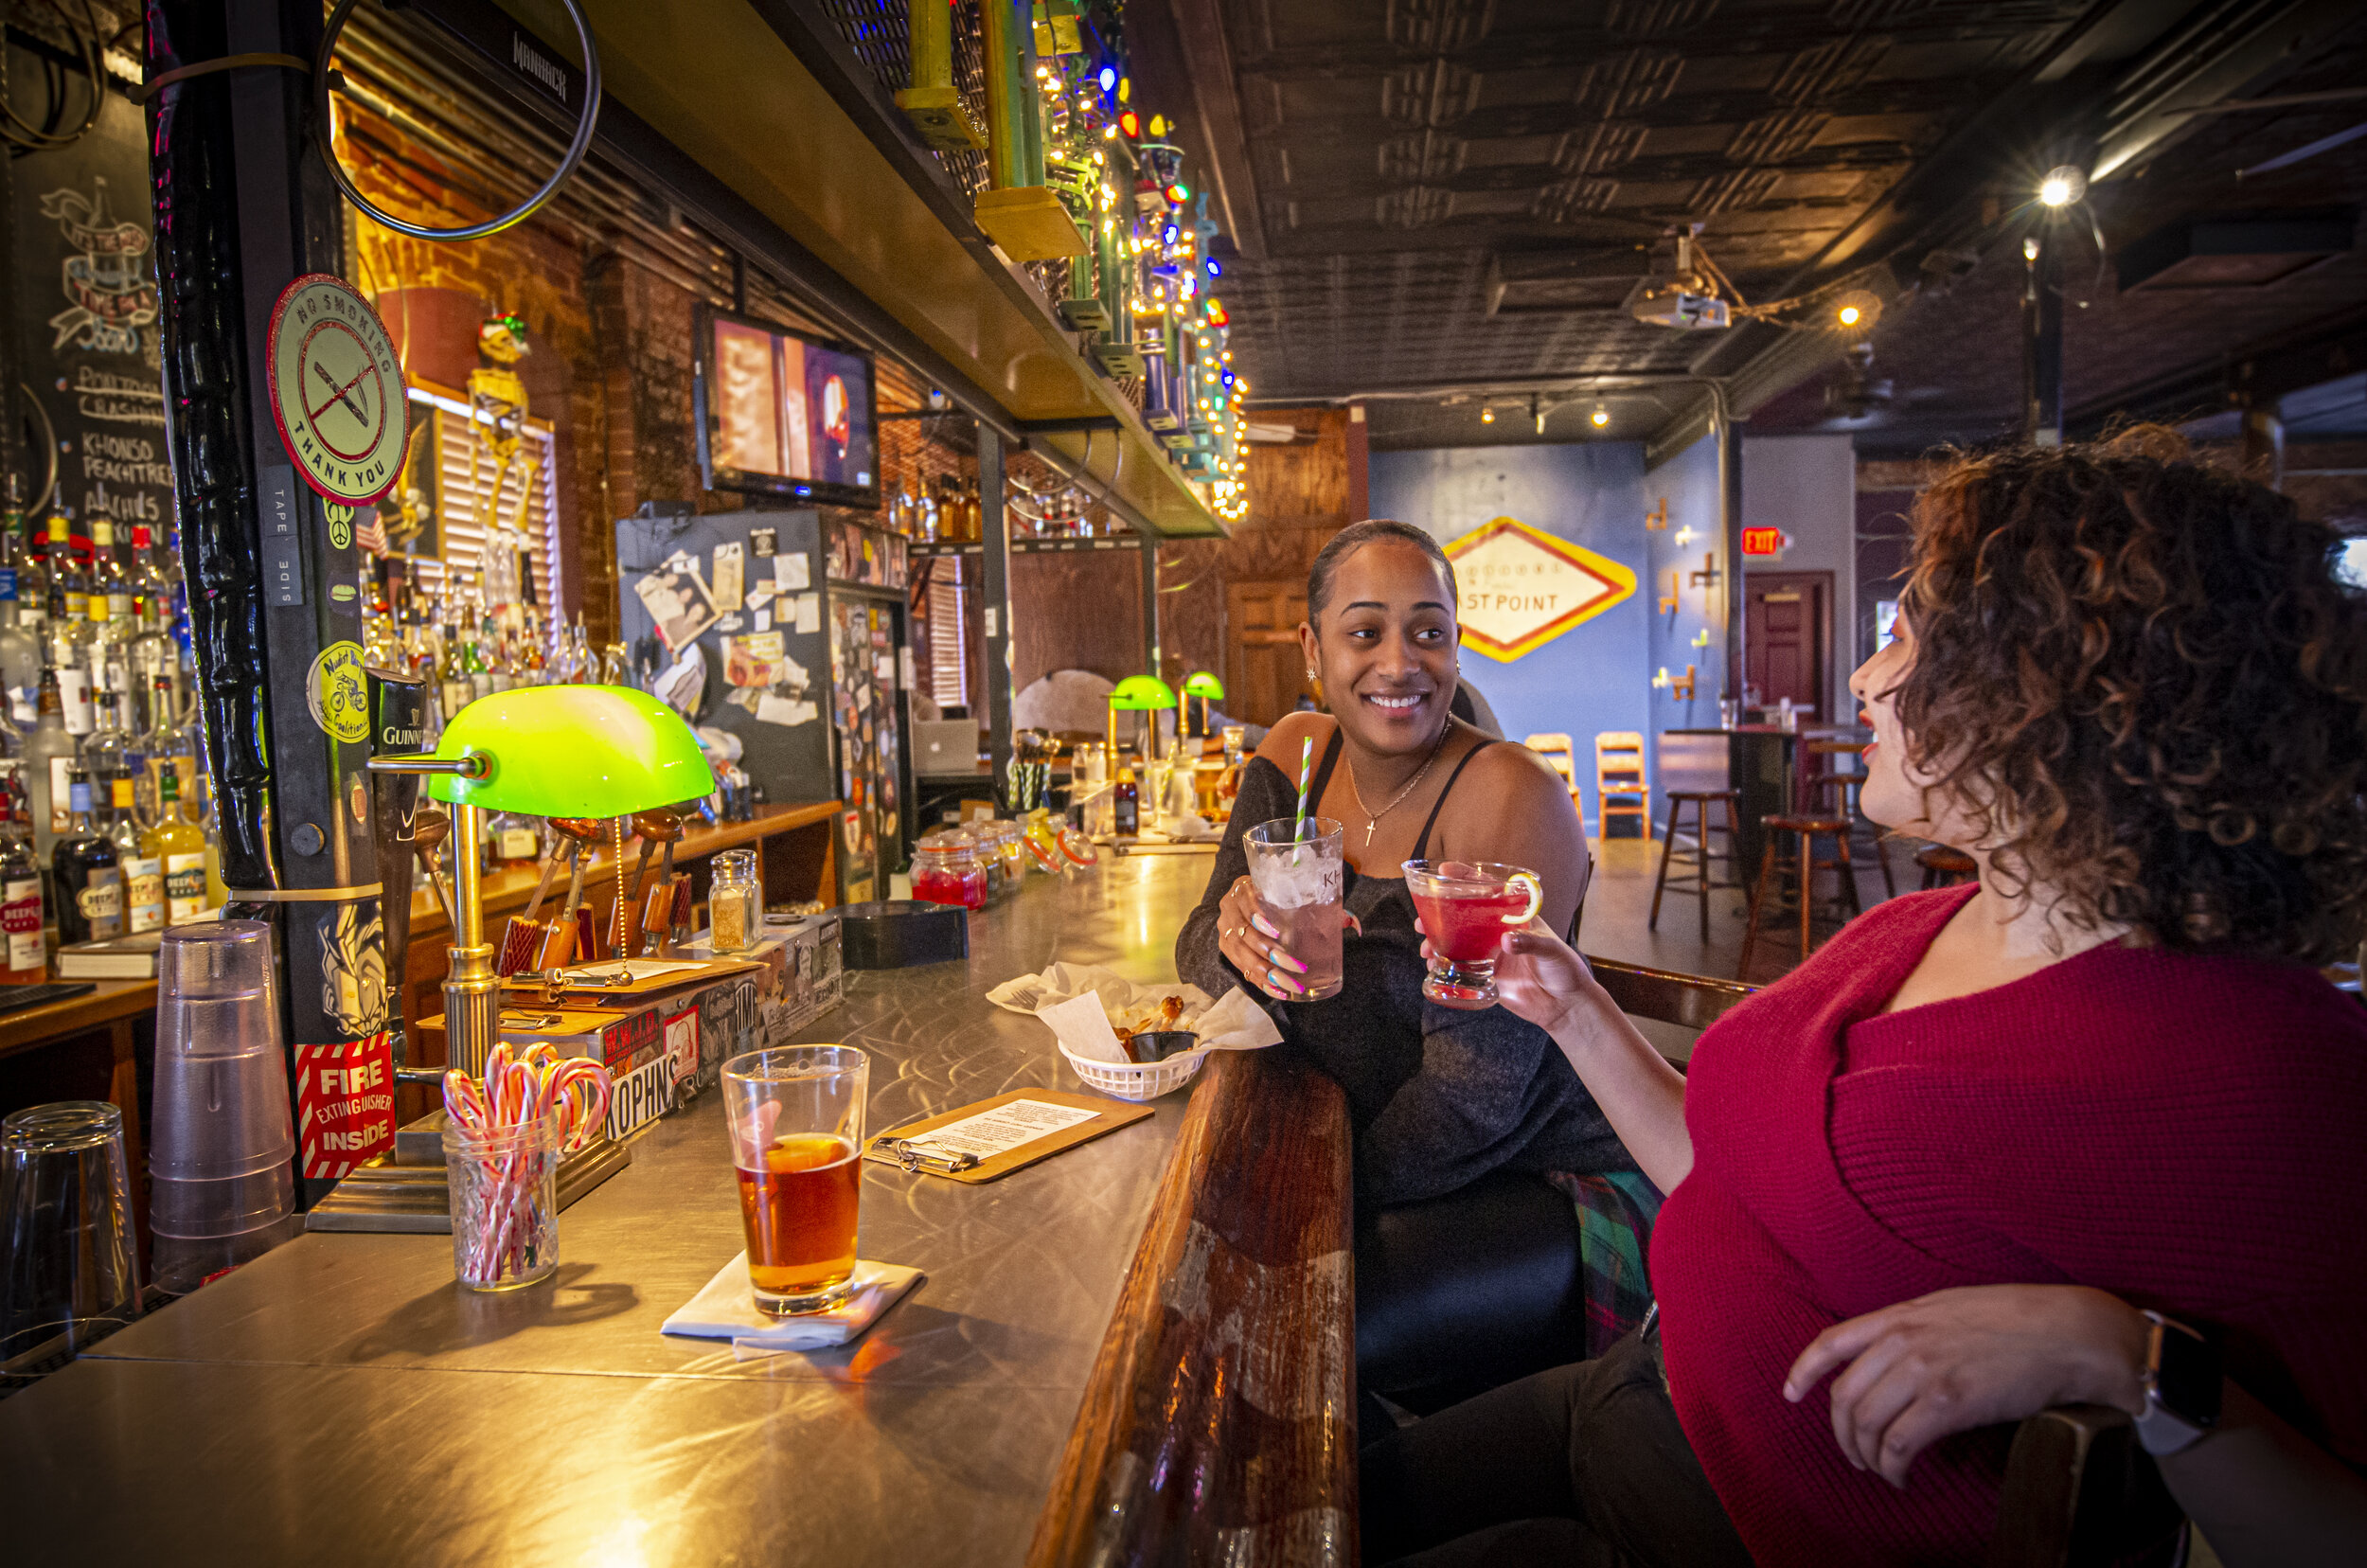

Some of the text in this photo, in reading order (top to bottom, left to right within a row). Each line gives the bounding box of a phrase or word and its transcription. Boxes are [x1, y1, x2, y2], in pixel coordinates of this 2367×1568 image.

[295, 294, 391, 374] NO SMOKING
[294, 420, 385, 488] THANK YOU
[275, 490, 287, 532] TAPE
[279, 561, 292, 601] SIDE
[1496, 594, 1557, 611] POINT
[320, 1058, 383, 1095] FIRE
[315, 1094, 392, 1125] EXTINGUISHER
[323, 1118, 389, 1150] INSIDE
